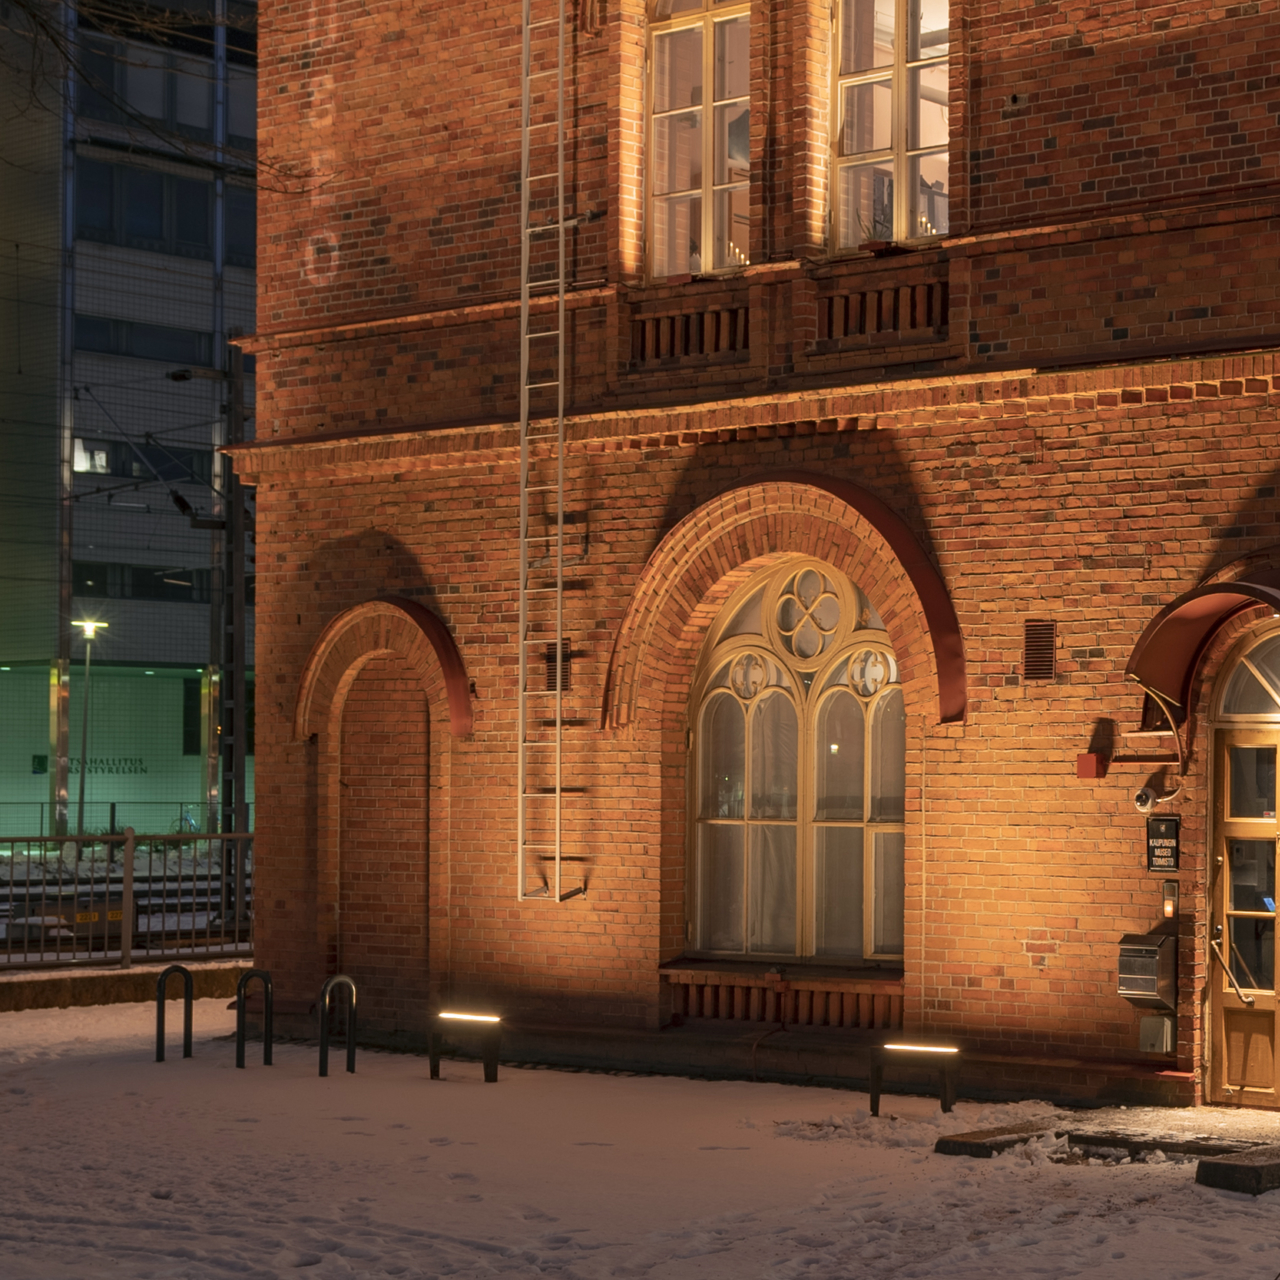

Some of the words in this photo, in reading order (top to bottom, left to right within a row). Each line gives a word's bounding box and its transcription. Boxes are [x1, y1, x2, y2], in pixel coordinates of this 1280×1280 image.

[68, 758, 144, 766] TSHALLITUS
[67, 766, 148, 774] RSSTYRELSEN
[1149, 838, 1176, 847] KAUPUNGIN
[1154, 848, 1171, 856] MUSEO
[1152, 857, 1174, 866] TOIMISTO
